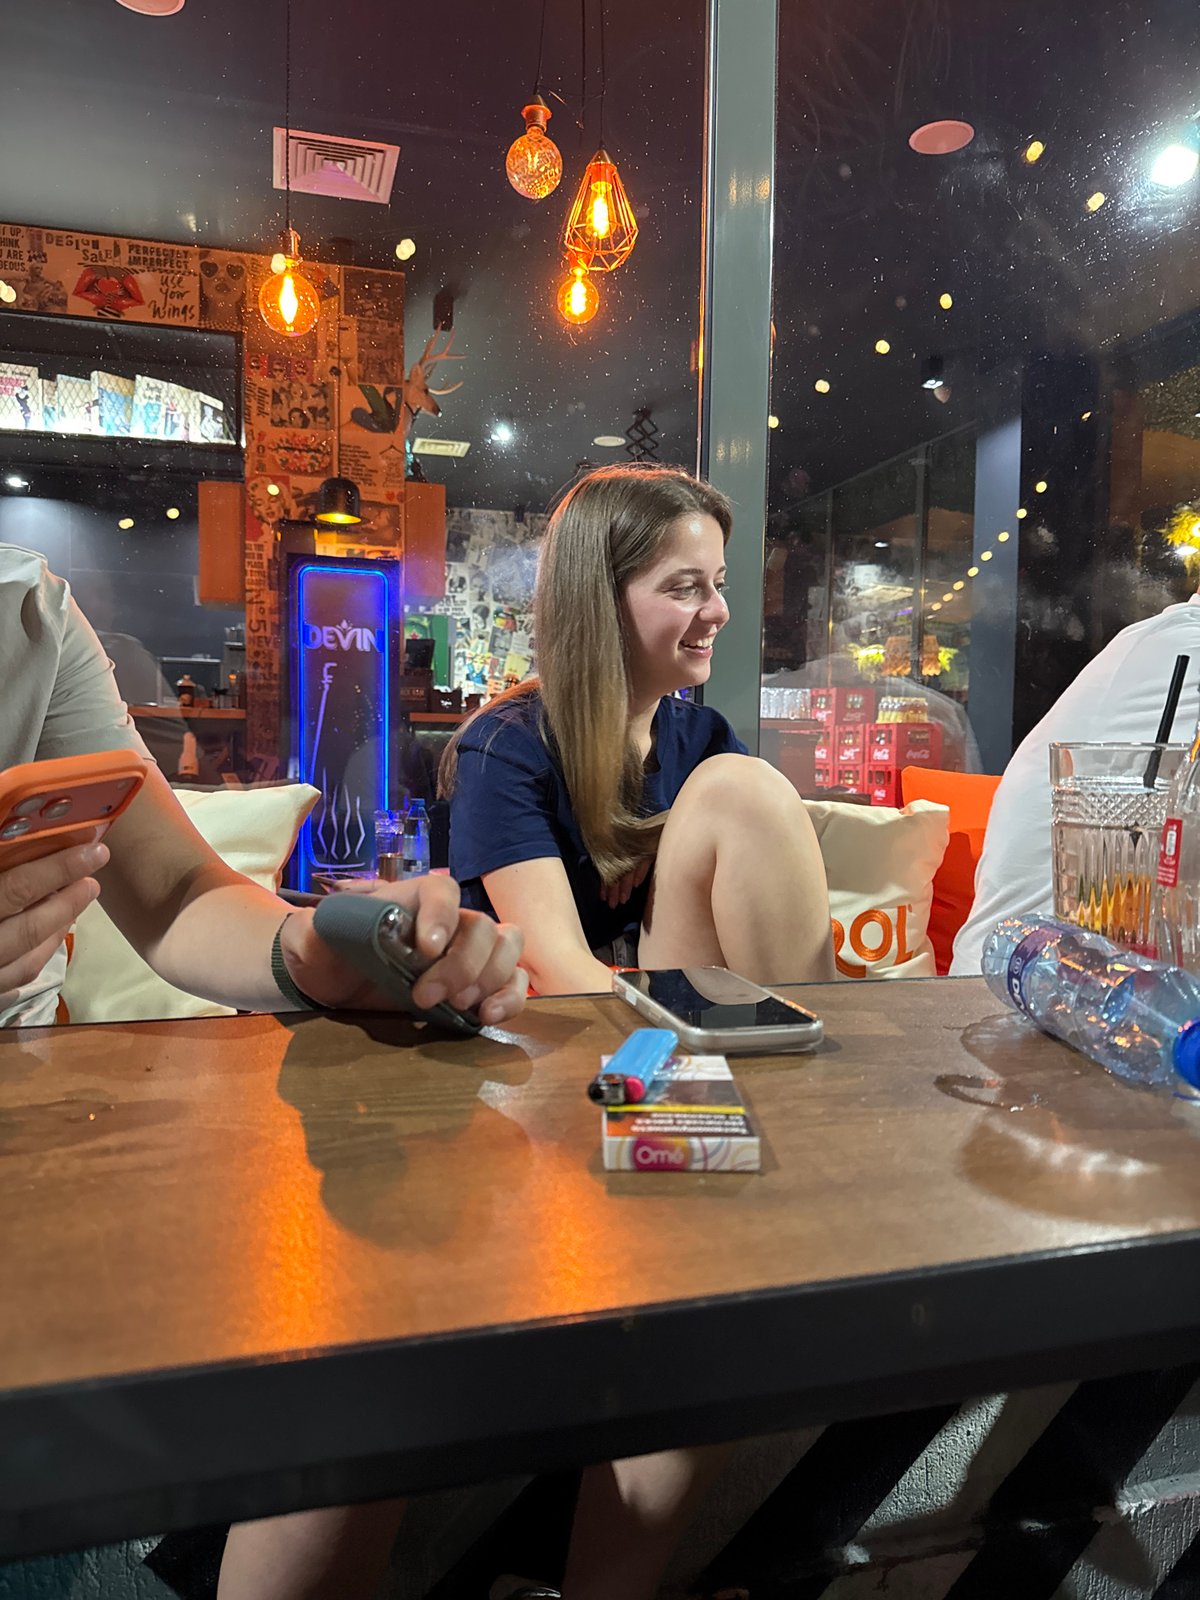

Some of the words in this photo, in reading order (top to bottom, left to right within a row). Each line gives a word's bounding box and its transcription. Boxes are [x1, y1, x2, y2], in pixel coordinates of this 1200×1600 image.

[0, 237, 20, 248] HINK
[46, 232, 99, 250] DESIGN
[7, 249, 23, 260] ARE
[128, 244, 189, 259] PERFECTLY
[128, 256, 189, 269] IMPERFECT
[304, 621, 384, 652] DEVIN
